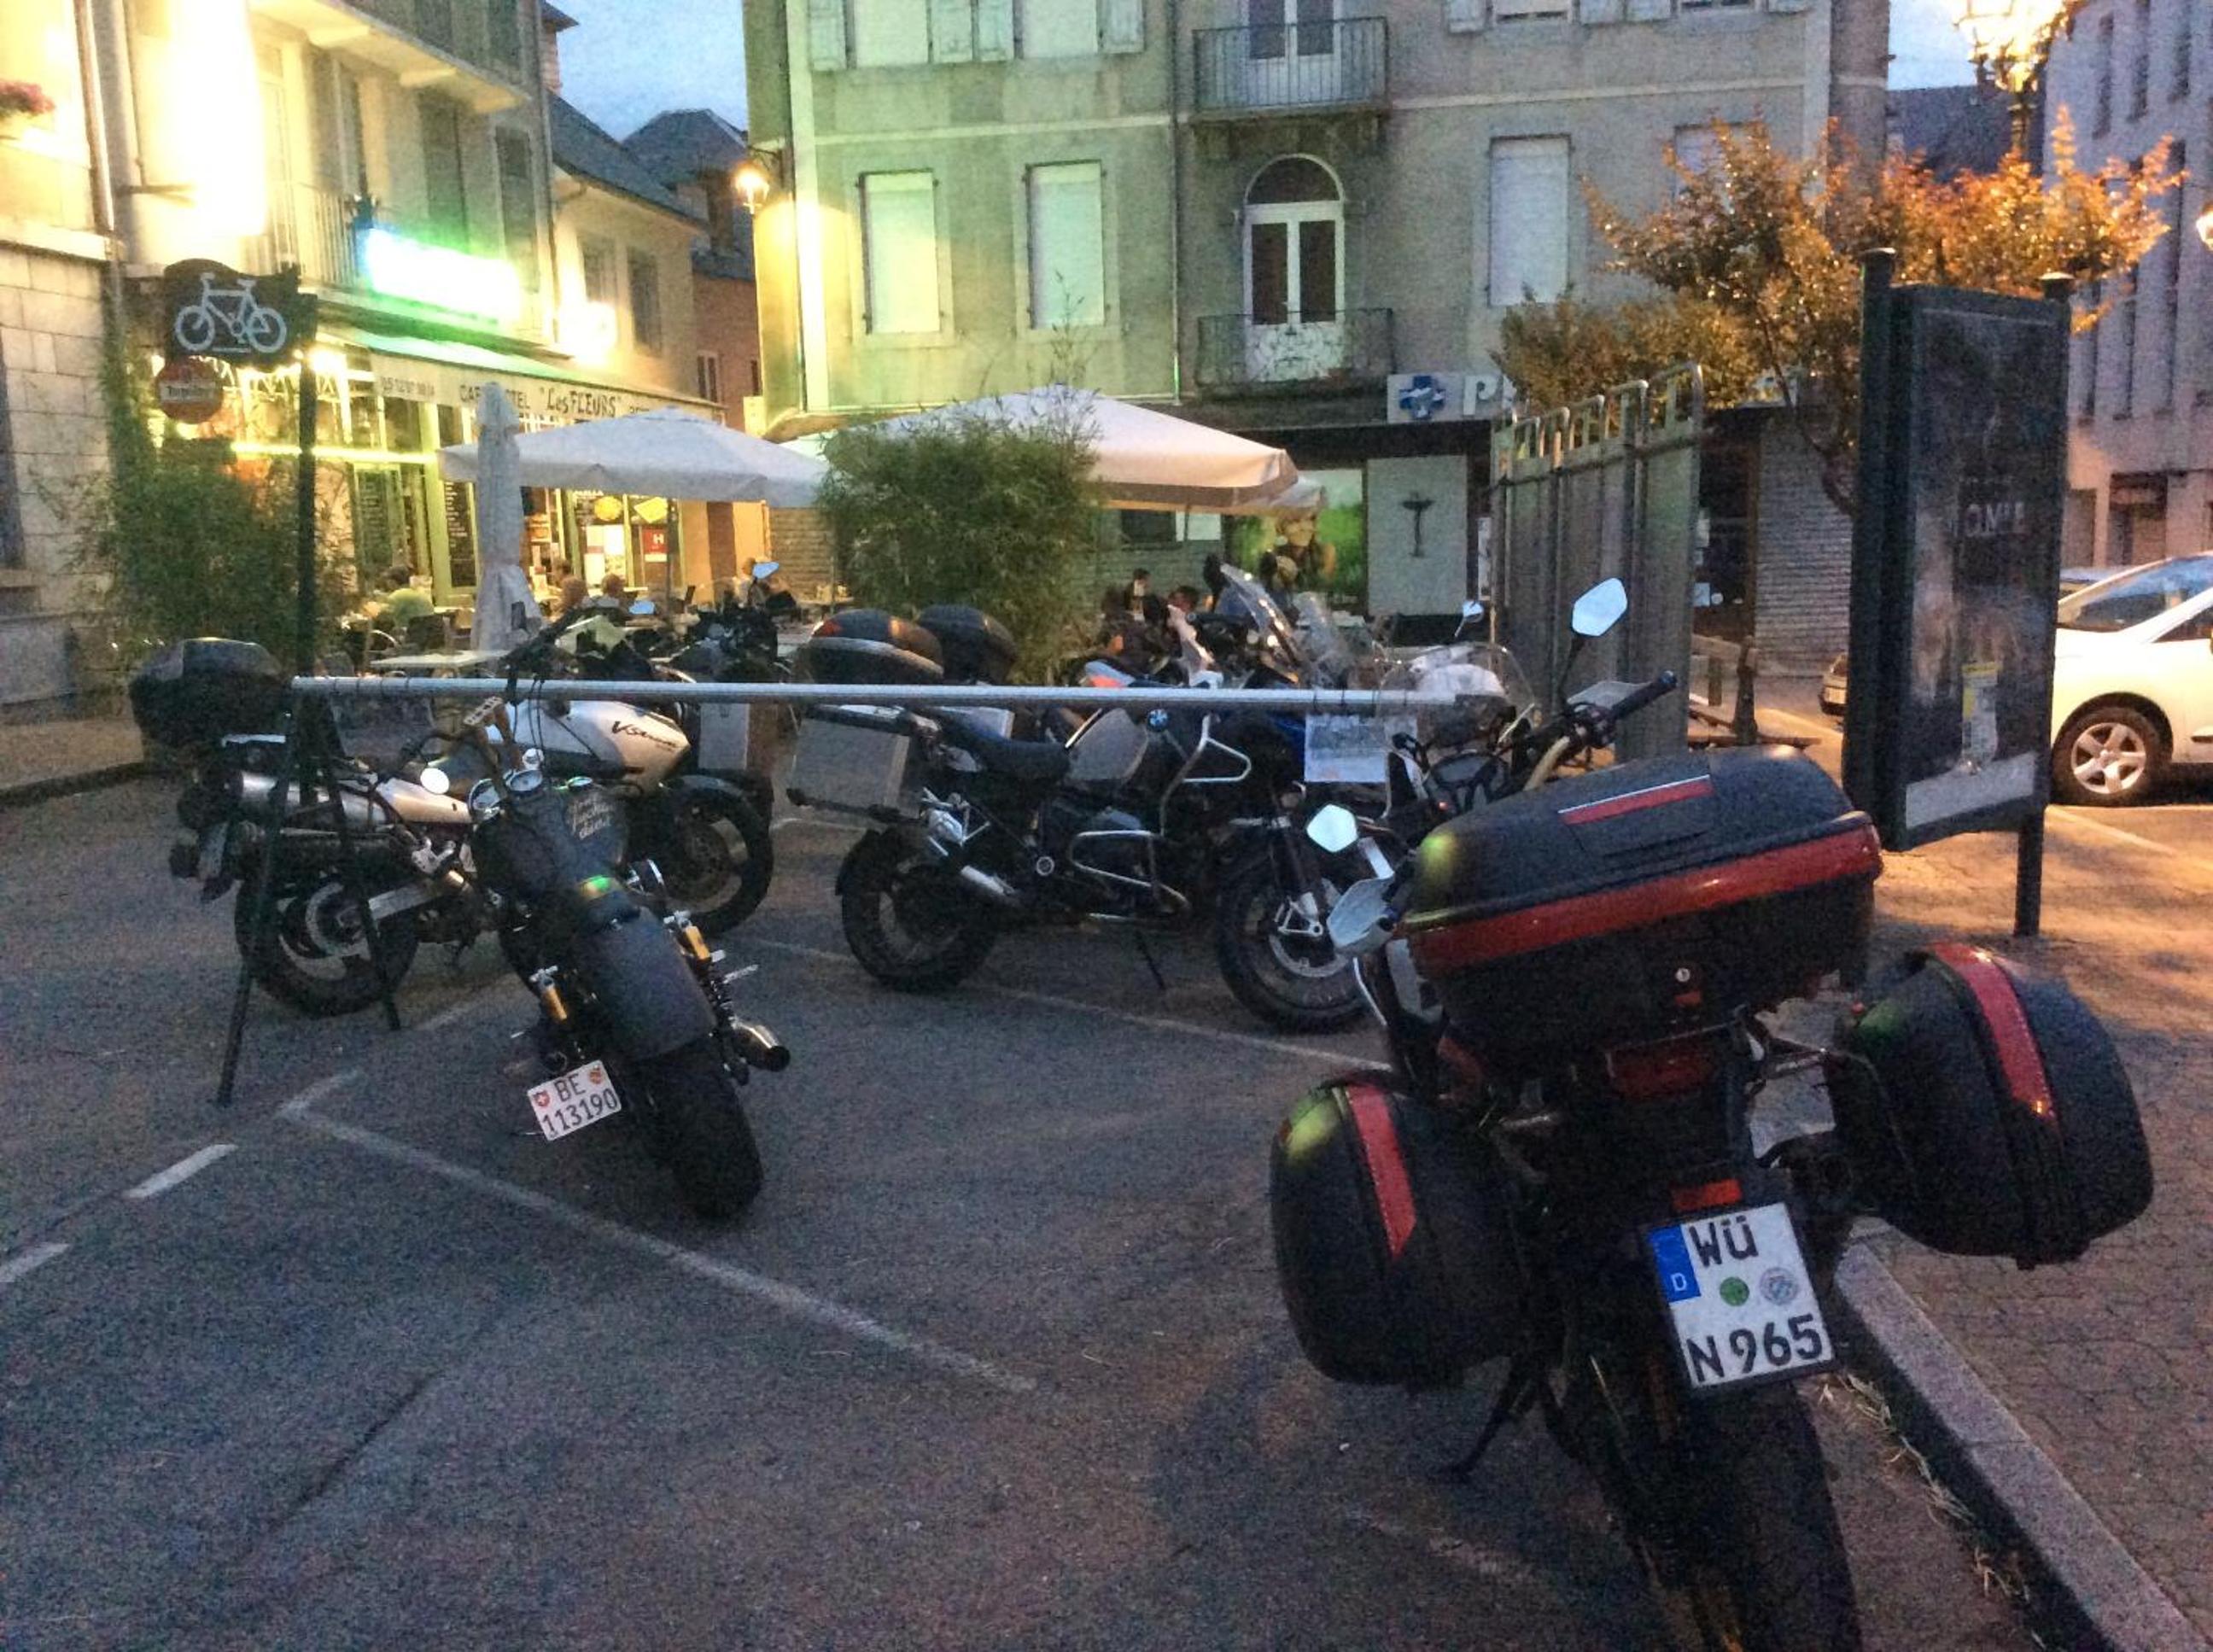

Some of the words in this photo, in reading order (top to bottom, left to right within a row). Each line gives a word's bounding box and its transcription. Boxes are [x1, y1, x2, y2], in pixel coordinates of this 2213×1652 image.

[460, 384, 481, 403] CAF
[553, 1073, 586, 1102] BE
[542, 1088, 617, 1138] 113190
[1689, 1215, 1759, 1267] WÜ
[1670, 1272, 1688, 1291] D
